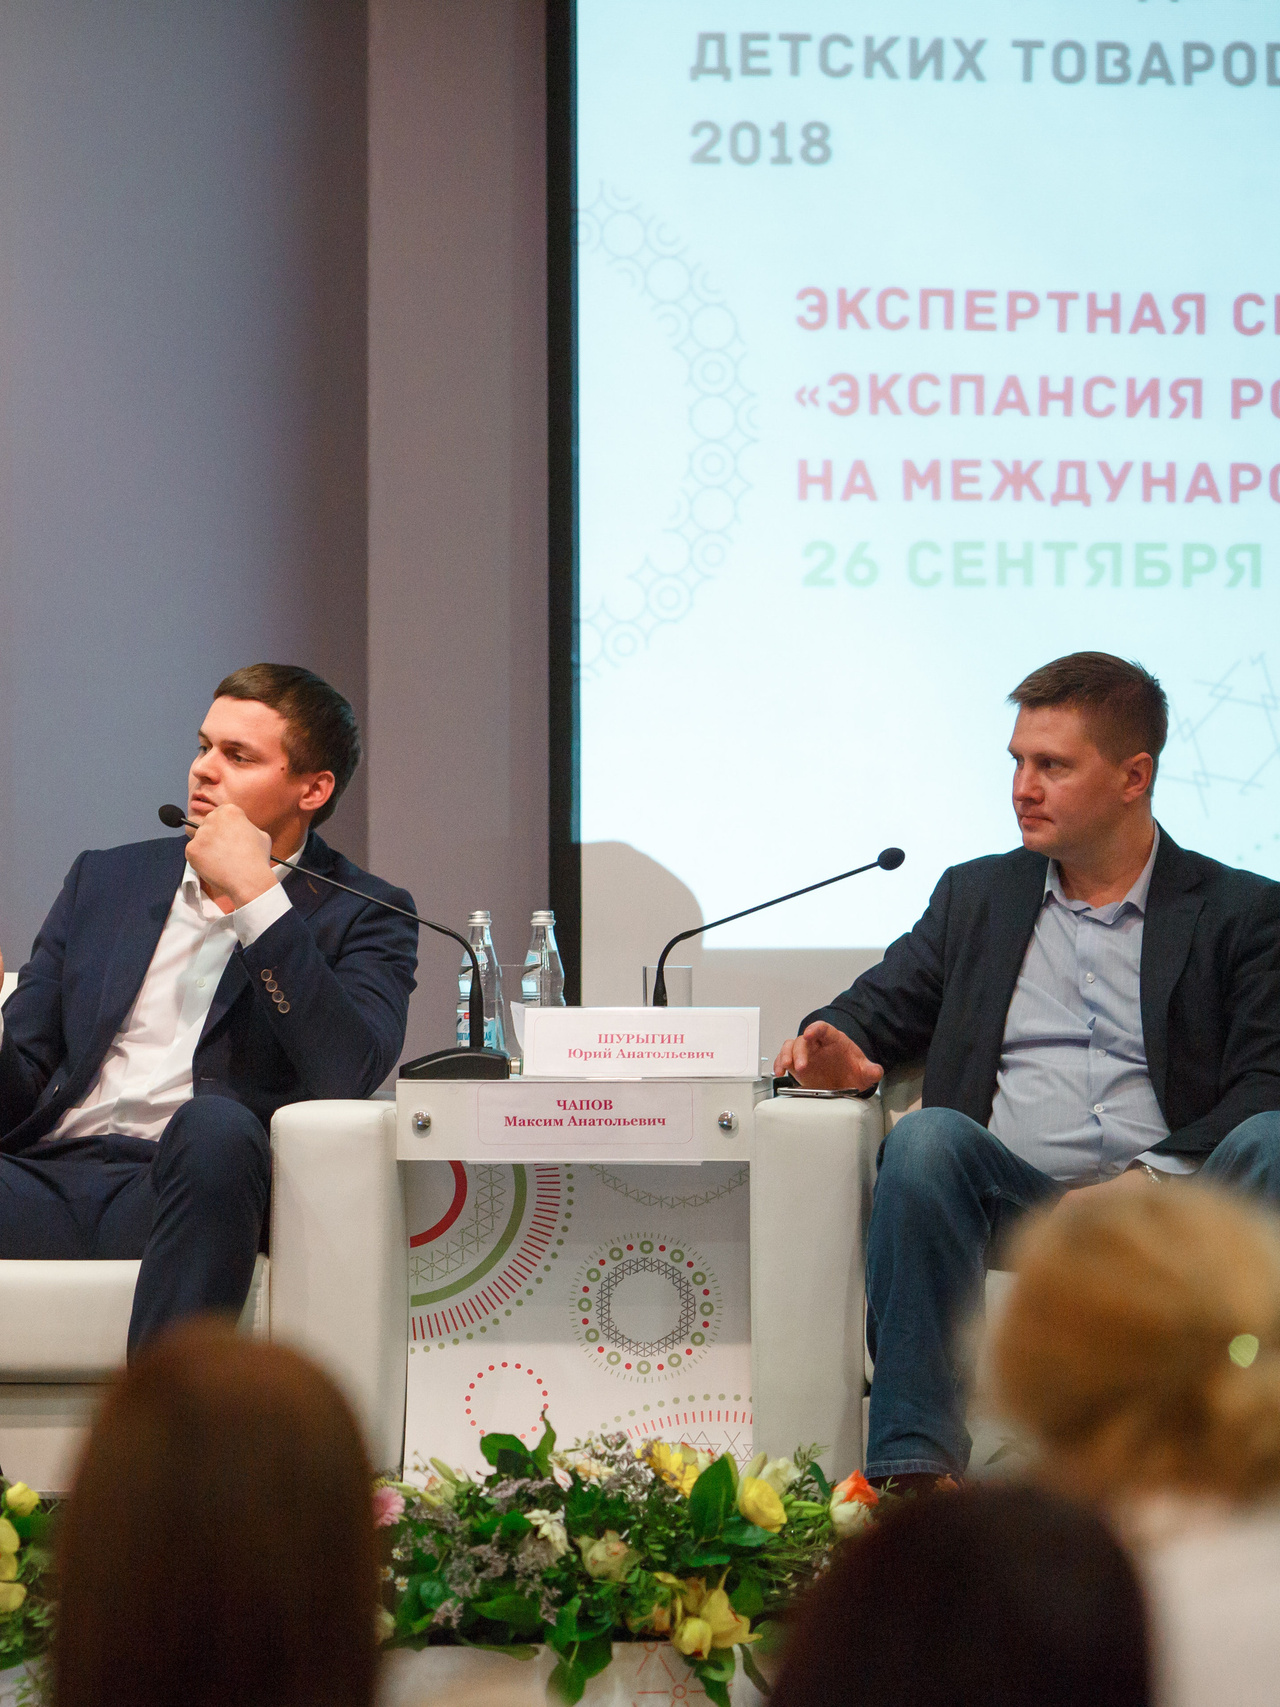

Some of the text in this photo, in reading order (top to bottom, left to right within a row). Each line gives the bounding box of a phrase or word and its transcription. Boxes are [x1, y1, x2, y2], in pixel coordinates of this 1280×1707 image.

[690, 32, 987, 82] ДЕТСКИХ
[690, 121, 833, 166] 2018
[795, 287, 1280, 337] ЭКСПЕРТНАЯ С
[794, 373, 1204, 420] «ЭКСПАНСИЯ
[797, 459, 878, 502] НА
[802, 540, 1263, 589] 26 СЕНТЯБРЯ
[567, 1048, 715, 1061] Юрий Анатольевич
[597, 1033, 685, 1045] ШУРЫГИН
[503, 1114, 666, 1127] Максим Анатольевич
[556, 1099, 613, 1111] ЧАПОВ
